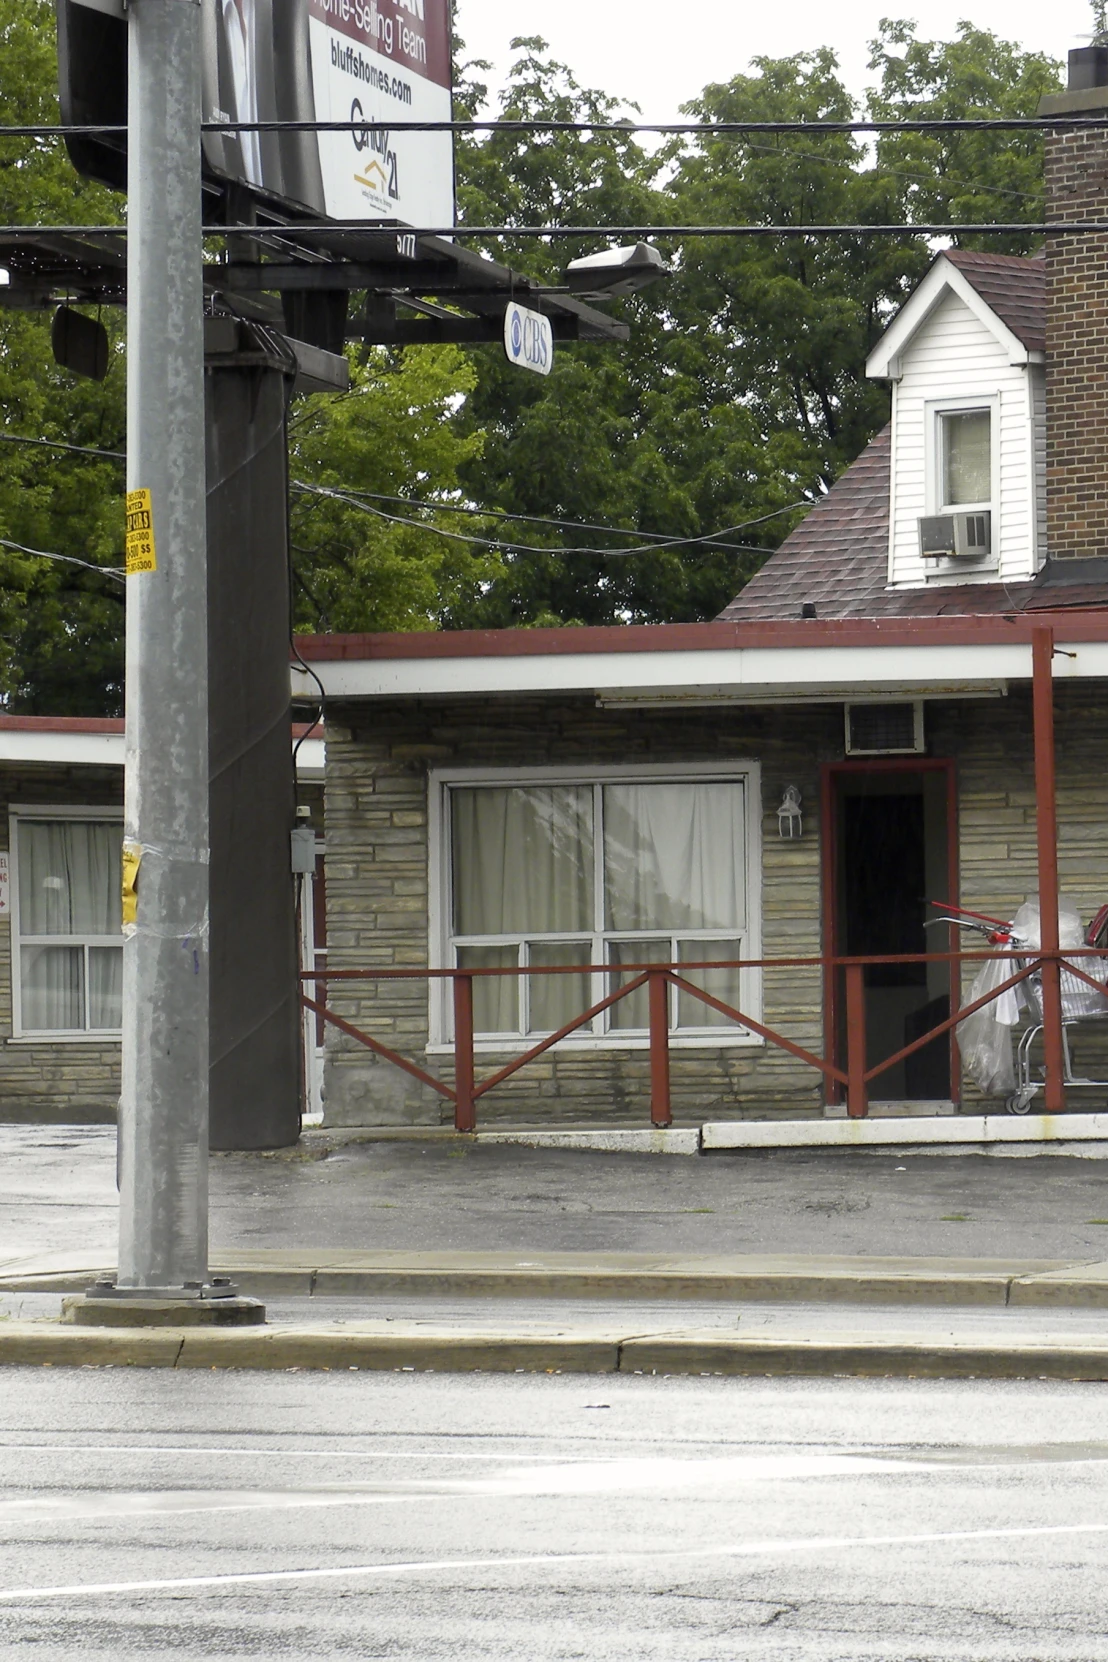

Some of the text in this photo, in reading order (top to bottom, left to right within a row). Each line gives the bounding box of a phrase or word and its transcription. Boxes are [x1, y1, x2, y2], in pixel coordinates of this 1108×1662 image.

[395, 14, 426, 64] Team
[330, 37, 412, 105] bluffshomes.com
[350, 98, 389, 163] Century
[387, 149, 399, 200] 21
[523, 315, 547, 368] CBS
